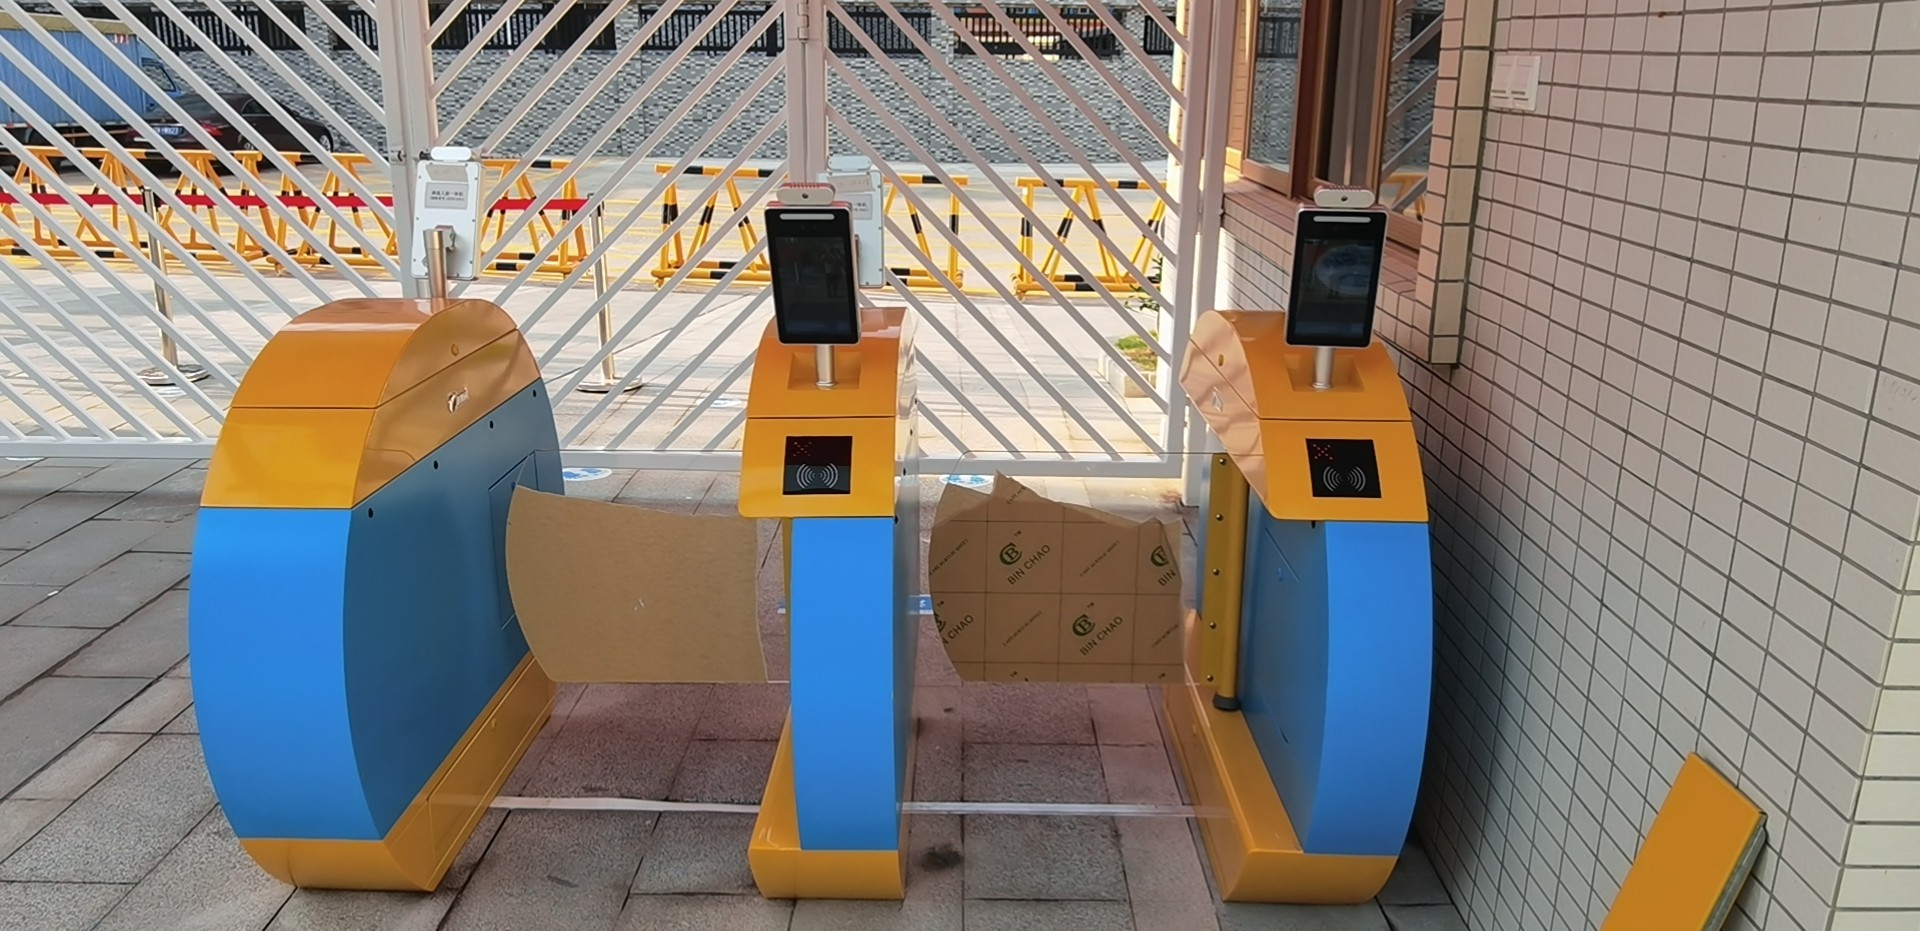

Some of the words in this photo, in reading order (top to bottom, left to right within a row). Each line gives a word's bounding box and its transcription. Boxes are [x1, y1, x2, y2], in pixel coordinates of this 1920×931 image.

[1007, 568, 1026, 585] BIN
[1023, 544, 1051, 570] CHAO
[1158, 569, 1177, 586] BIN
[947, 614, 974, 640] CHAO
[1079, 639, 1098, 656] BIN
[1096, 616, 1123, 641] CHAO
